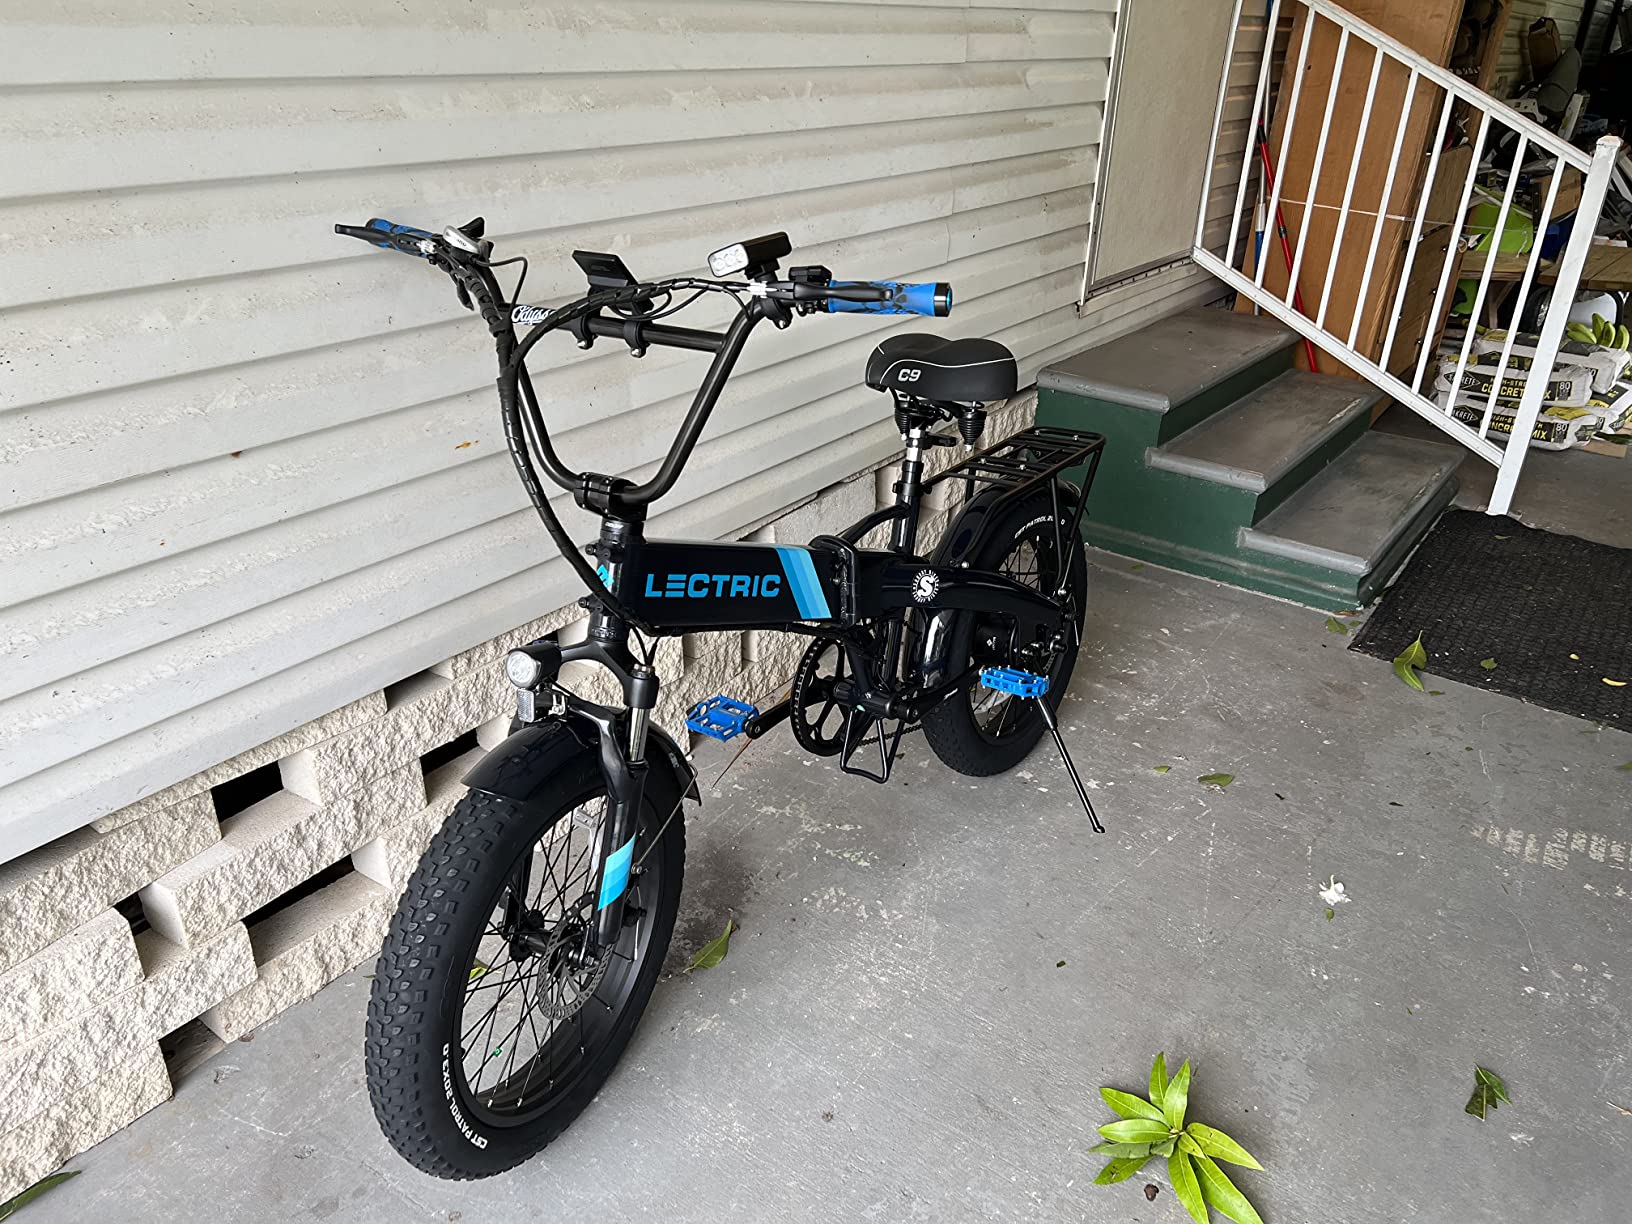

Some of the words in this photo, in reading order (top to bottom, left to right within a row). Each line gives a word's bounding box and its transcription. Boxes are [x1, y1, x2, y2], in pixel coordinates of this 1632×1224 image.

[511, 305, 557, 325] Odyss
[898, 368, 921, 382] C9
[1481, 383, 1524, 398] COCRET
[1559, 381, 1570, 390] 80
[1555, 423, 1567, 432] 80
[645, 573, 781, 598] LECTRIC
[449, 1097, 474, 1140] PATROL
[470, 1134, 488, 1149] CST
